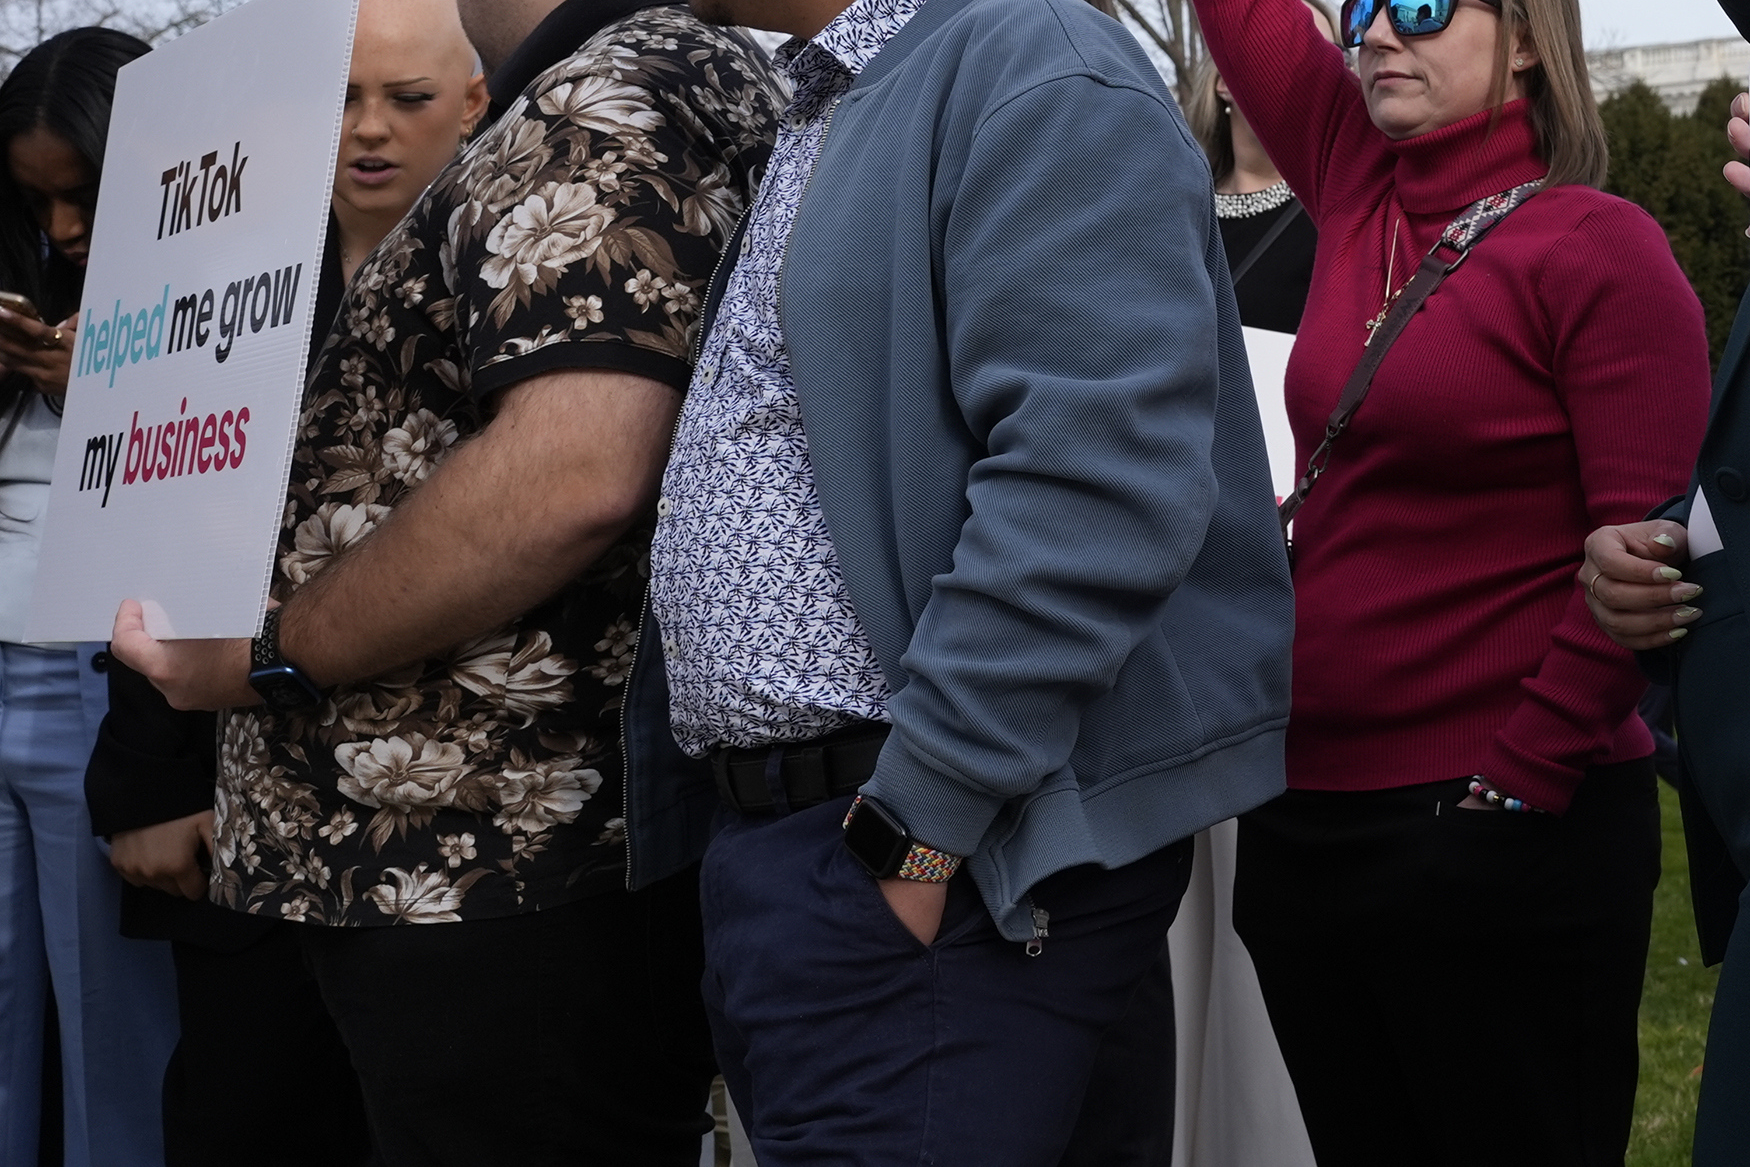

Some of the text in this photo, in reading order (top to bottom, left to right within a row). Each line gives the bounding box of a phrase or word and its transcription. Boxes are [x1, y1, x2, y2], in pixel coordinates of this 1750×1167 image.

[157, 141, 249, 241] TikTok
[78, 263, 303, 389] helped me grow
[79, 397, 251, 509] my business
